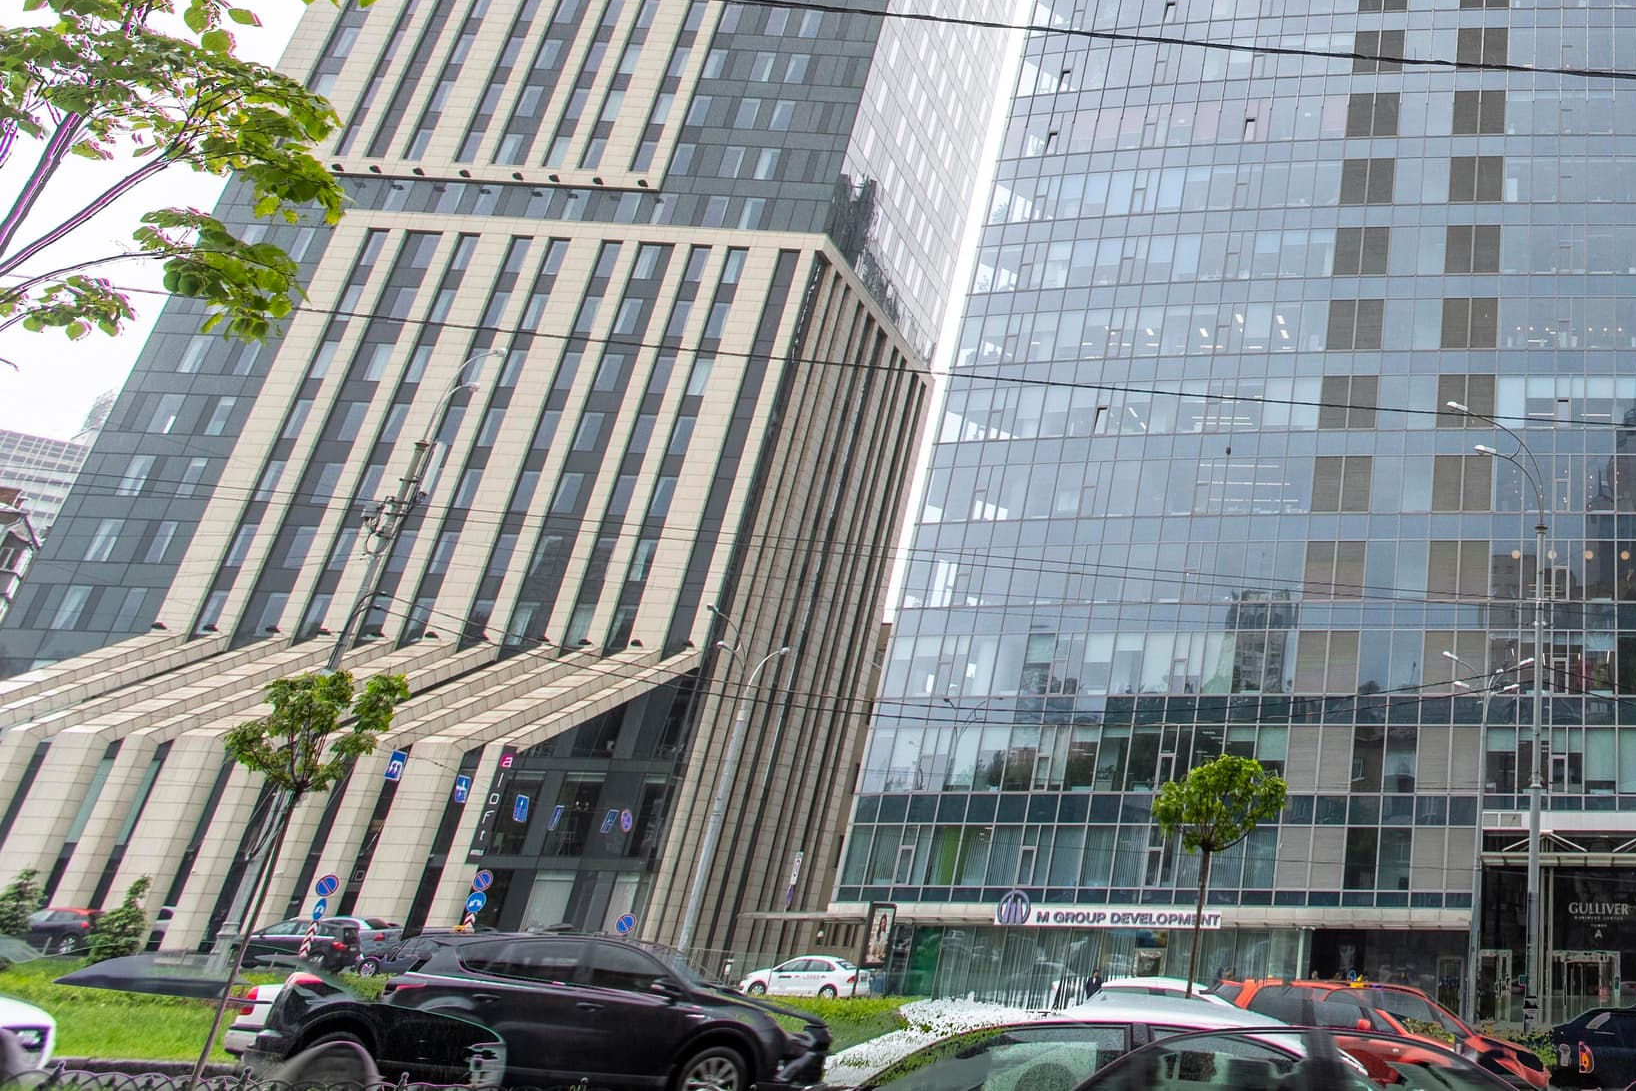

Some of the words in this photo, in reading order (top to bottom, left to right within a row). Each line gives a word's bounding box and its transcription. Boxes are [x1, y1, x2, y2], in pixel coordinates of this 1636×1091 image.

[1568, 902, 1629, 915] GULLIVER
[1036, 911, 1050, 923] M
[1053, 911, 1106, 924] GROUP
[1110, 912, 1221, 926] DEVELOPMENT
[1594, 929, 1603, 939] A
